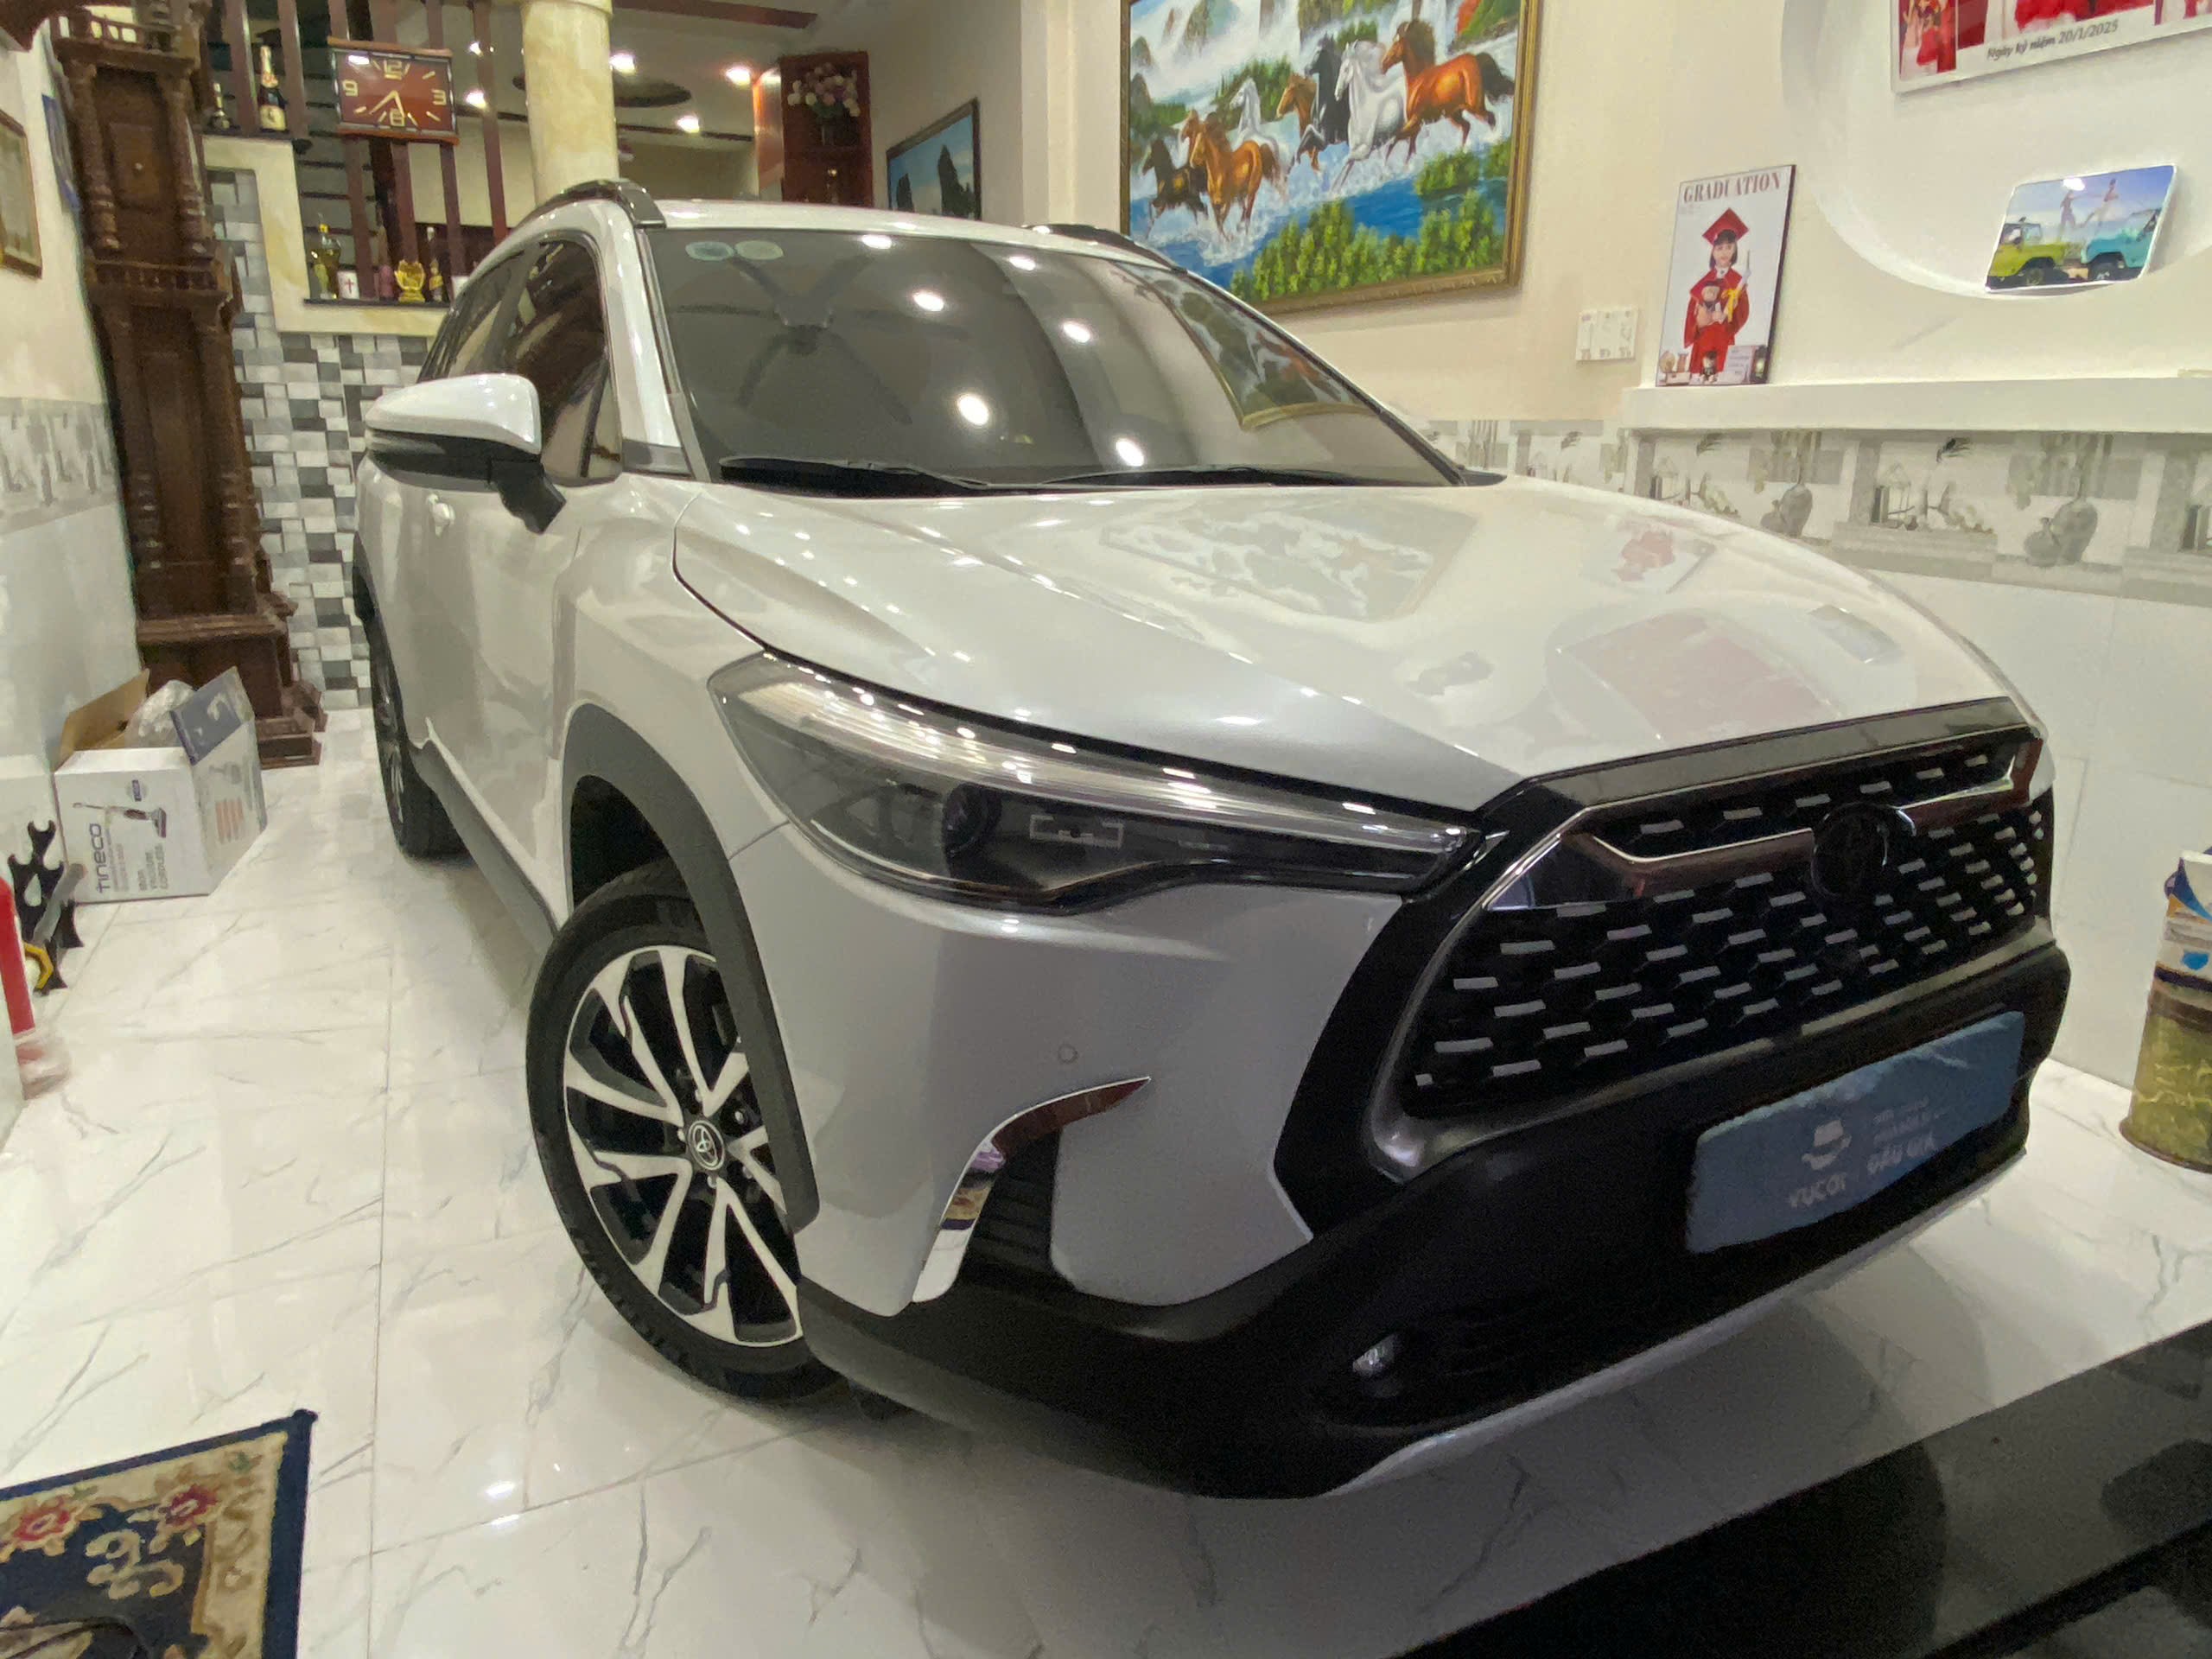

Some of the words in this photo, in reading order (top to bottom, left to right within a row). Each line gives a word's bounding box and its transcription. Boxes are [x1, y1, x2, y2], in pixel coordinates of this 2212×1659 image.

[2058, 18, 2120, 44] 20/1/2025
[383, 59, 403, 80] 12
[342, 79, 359, 97] 9
[432, 89, 447, 105] 3
[390, 108, 405, 127] 6
[1683, 172, 1783, 203] GRADUATION
